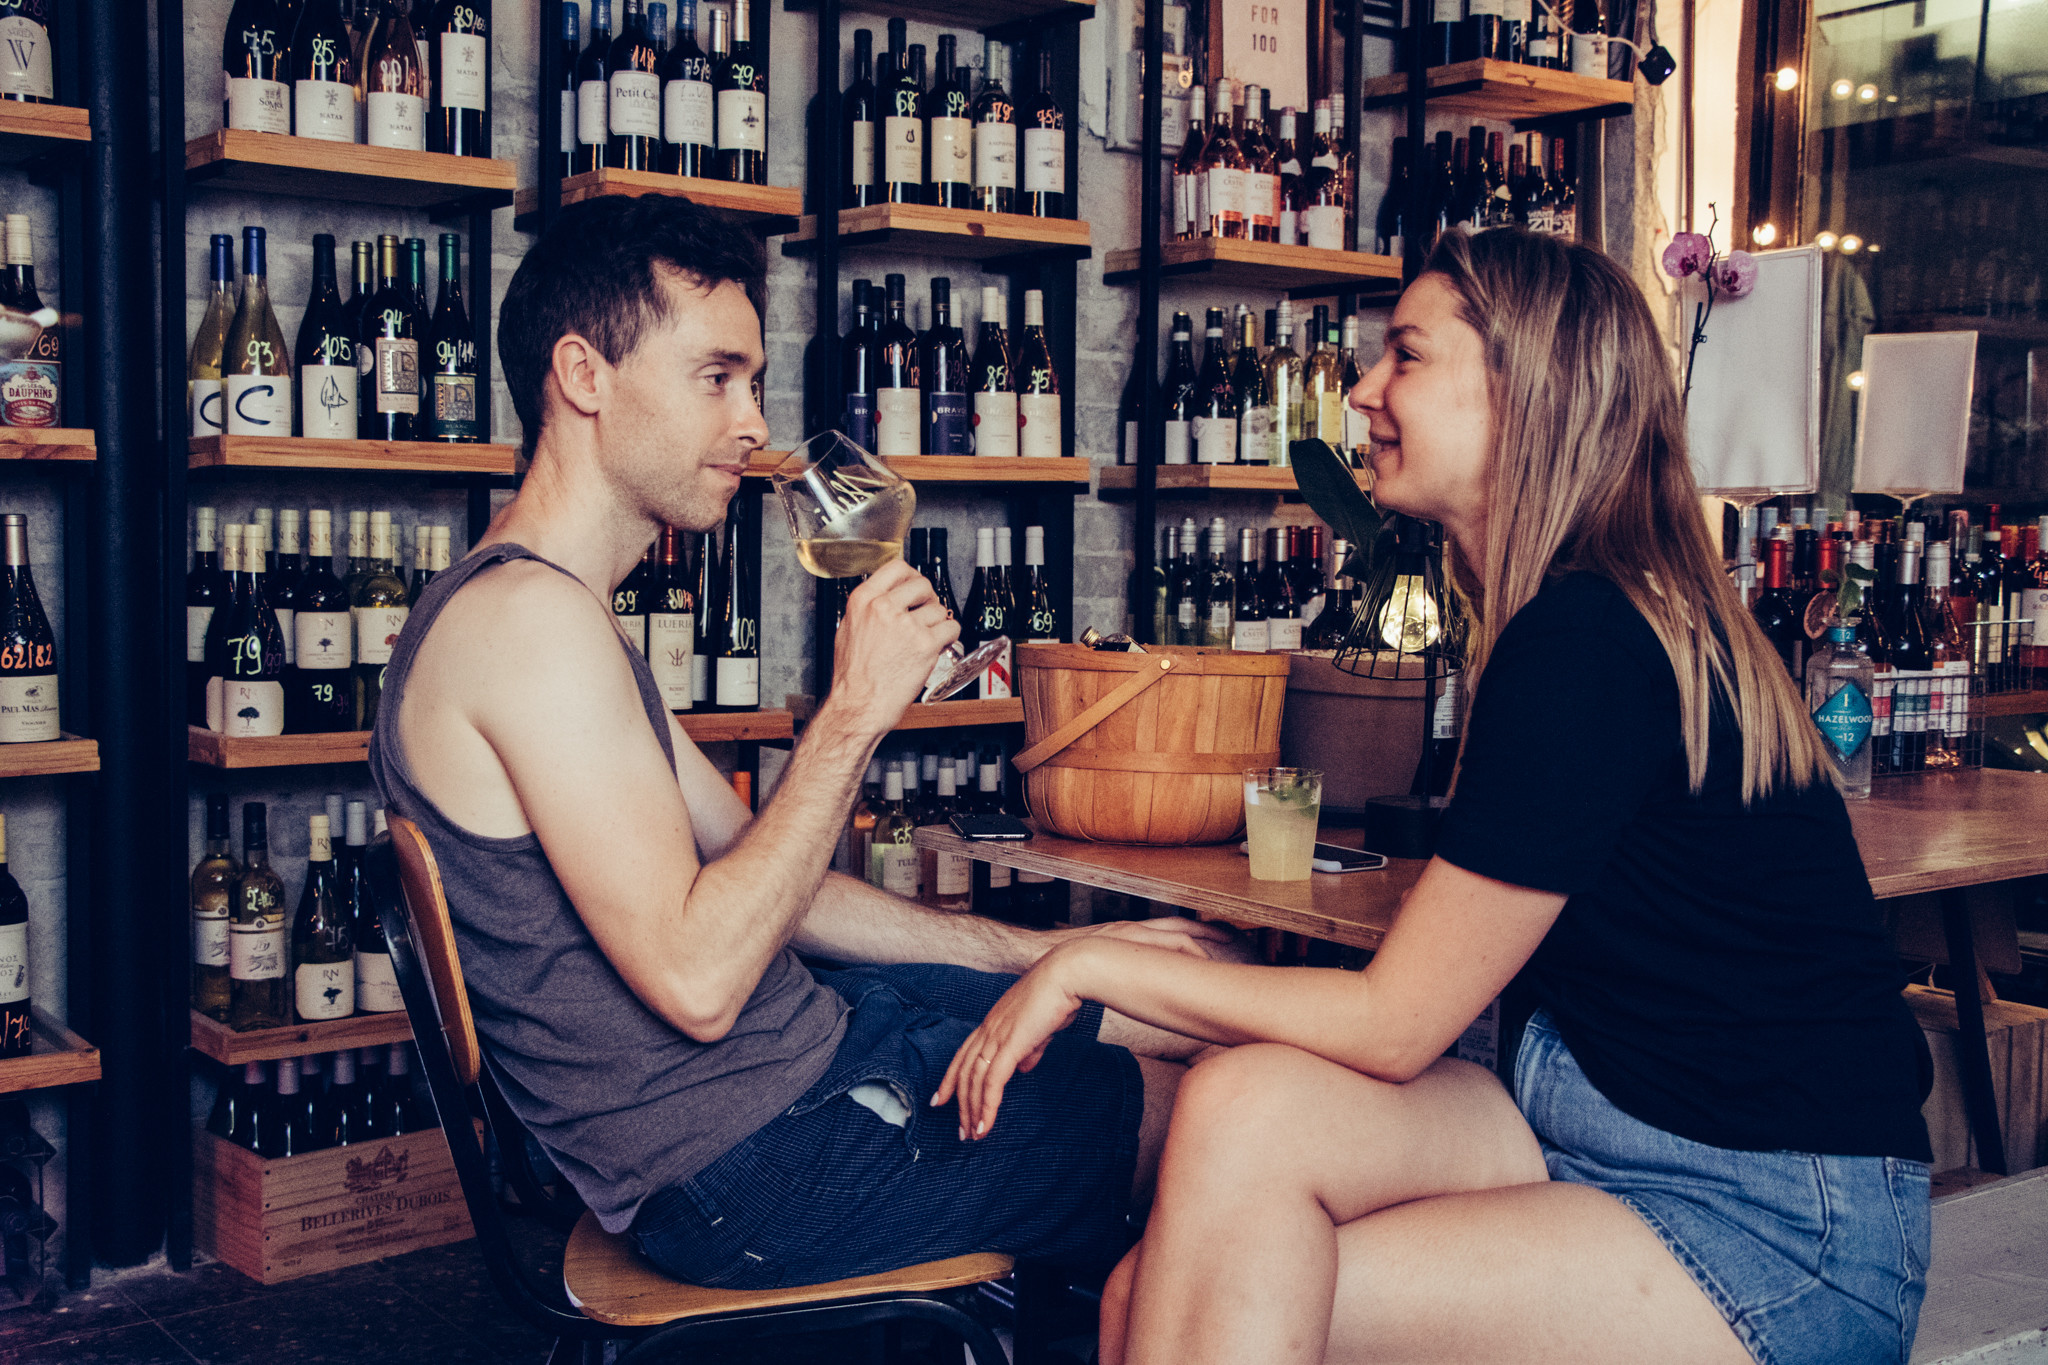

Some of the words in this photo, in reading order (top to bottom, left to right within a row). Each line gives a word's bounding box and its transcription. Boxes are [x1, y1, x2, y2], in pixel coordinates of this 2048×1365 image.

[1251, 5, 1279, 25] FOR
[313, 39, 335, 66] 85
[1252, 33, 1277, 53] 100
[732, 63, 754, 86] 79
[616, 87, 639, 98] Petit
[948, 91, 965, 112] 99
[247, 340, 274, 367] 93
[321, 333, 351, 360] 105
[987, 365, 1006, 387] 85
[1031, 368, 1049, 389] 75
[9, 387, 52, 398] DAUPHINS
[985, 606, 1003, 629] 69
[1033, 612, 1052, 633] 69
[312, 684, 333, 702] 79
[22, 704, 39, 712] MAS
[1842, 732, 1855, 742] 12
[323, 969, 340, 982] RN
[301, 1203, 392, 1232] BELLERIVES
[397, 1190, 450, 1211] DUBOIS
